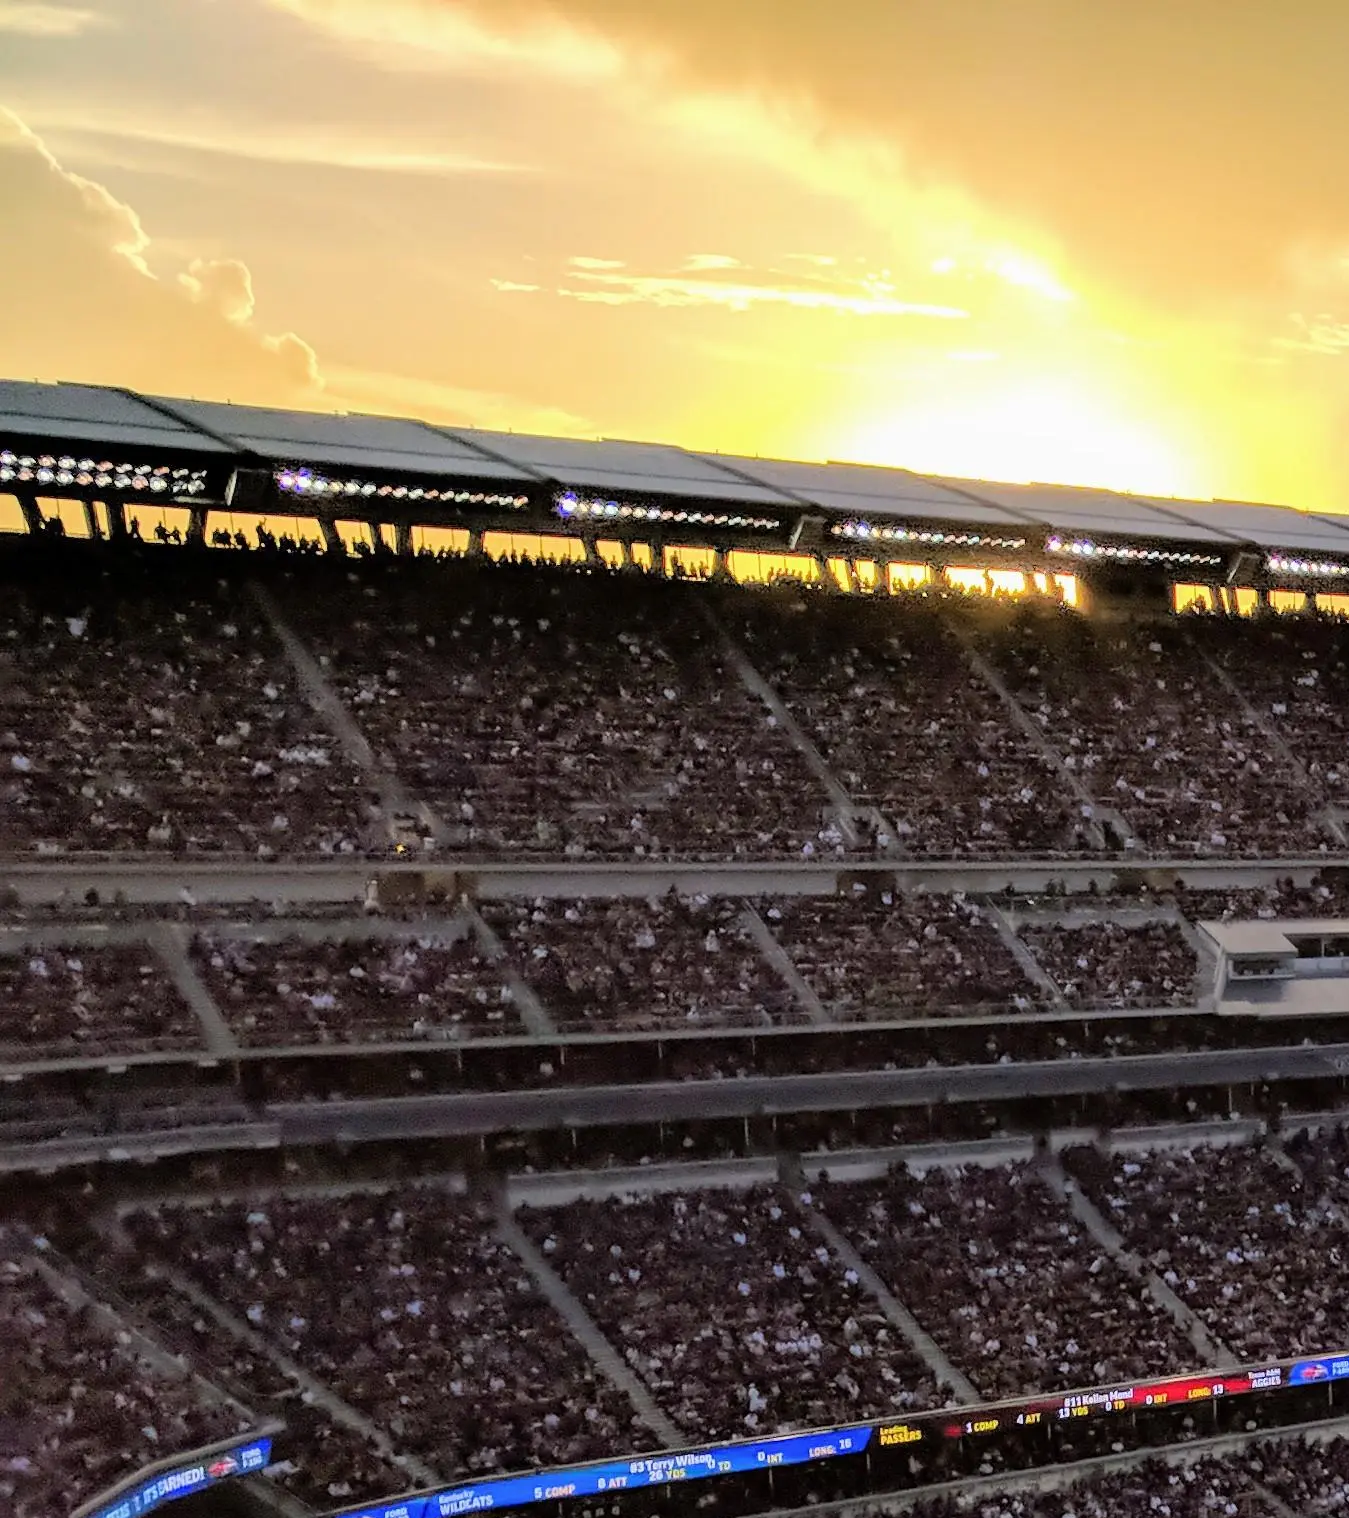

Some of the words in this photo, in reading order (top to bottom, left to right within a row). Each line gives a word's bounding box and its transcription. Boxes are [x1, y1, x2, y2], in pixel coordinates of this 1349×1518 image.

[1016, 1414, 1024, 1425] 4
[880, 1430, 922, 1446] PASSERS
[645, 1458, 675, 1474] Terry
[675, 1454, 712, 1468] Wilson
[757, 1451, 765, 1462] 0
[767, 1453, 784, 1464] INT
[719, 1461, 731, 1472] TD
[649, 1470, 663, 1482] 26
[665, 1468, 686, 1479] YDS
[608, 1477, 627, 1489] ATT
[439, 1490, 475, 1504] Kentucky
[545, 1484, 576, 1498] COMP
[440, 1495, 494, 1517] WILDCATS
